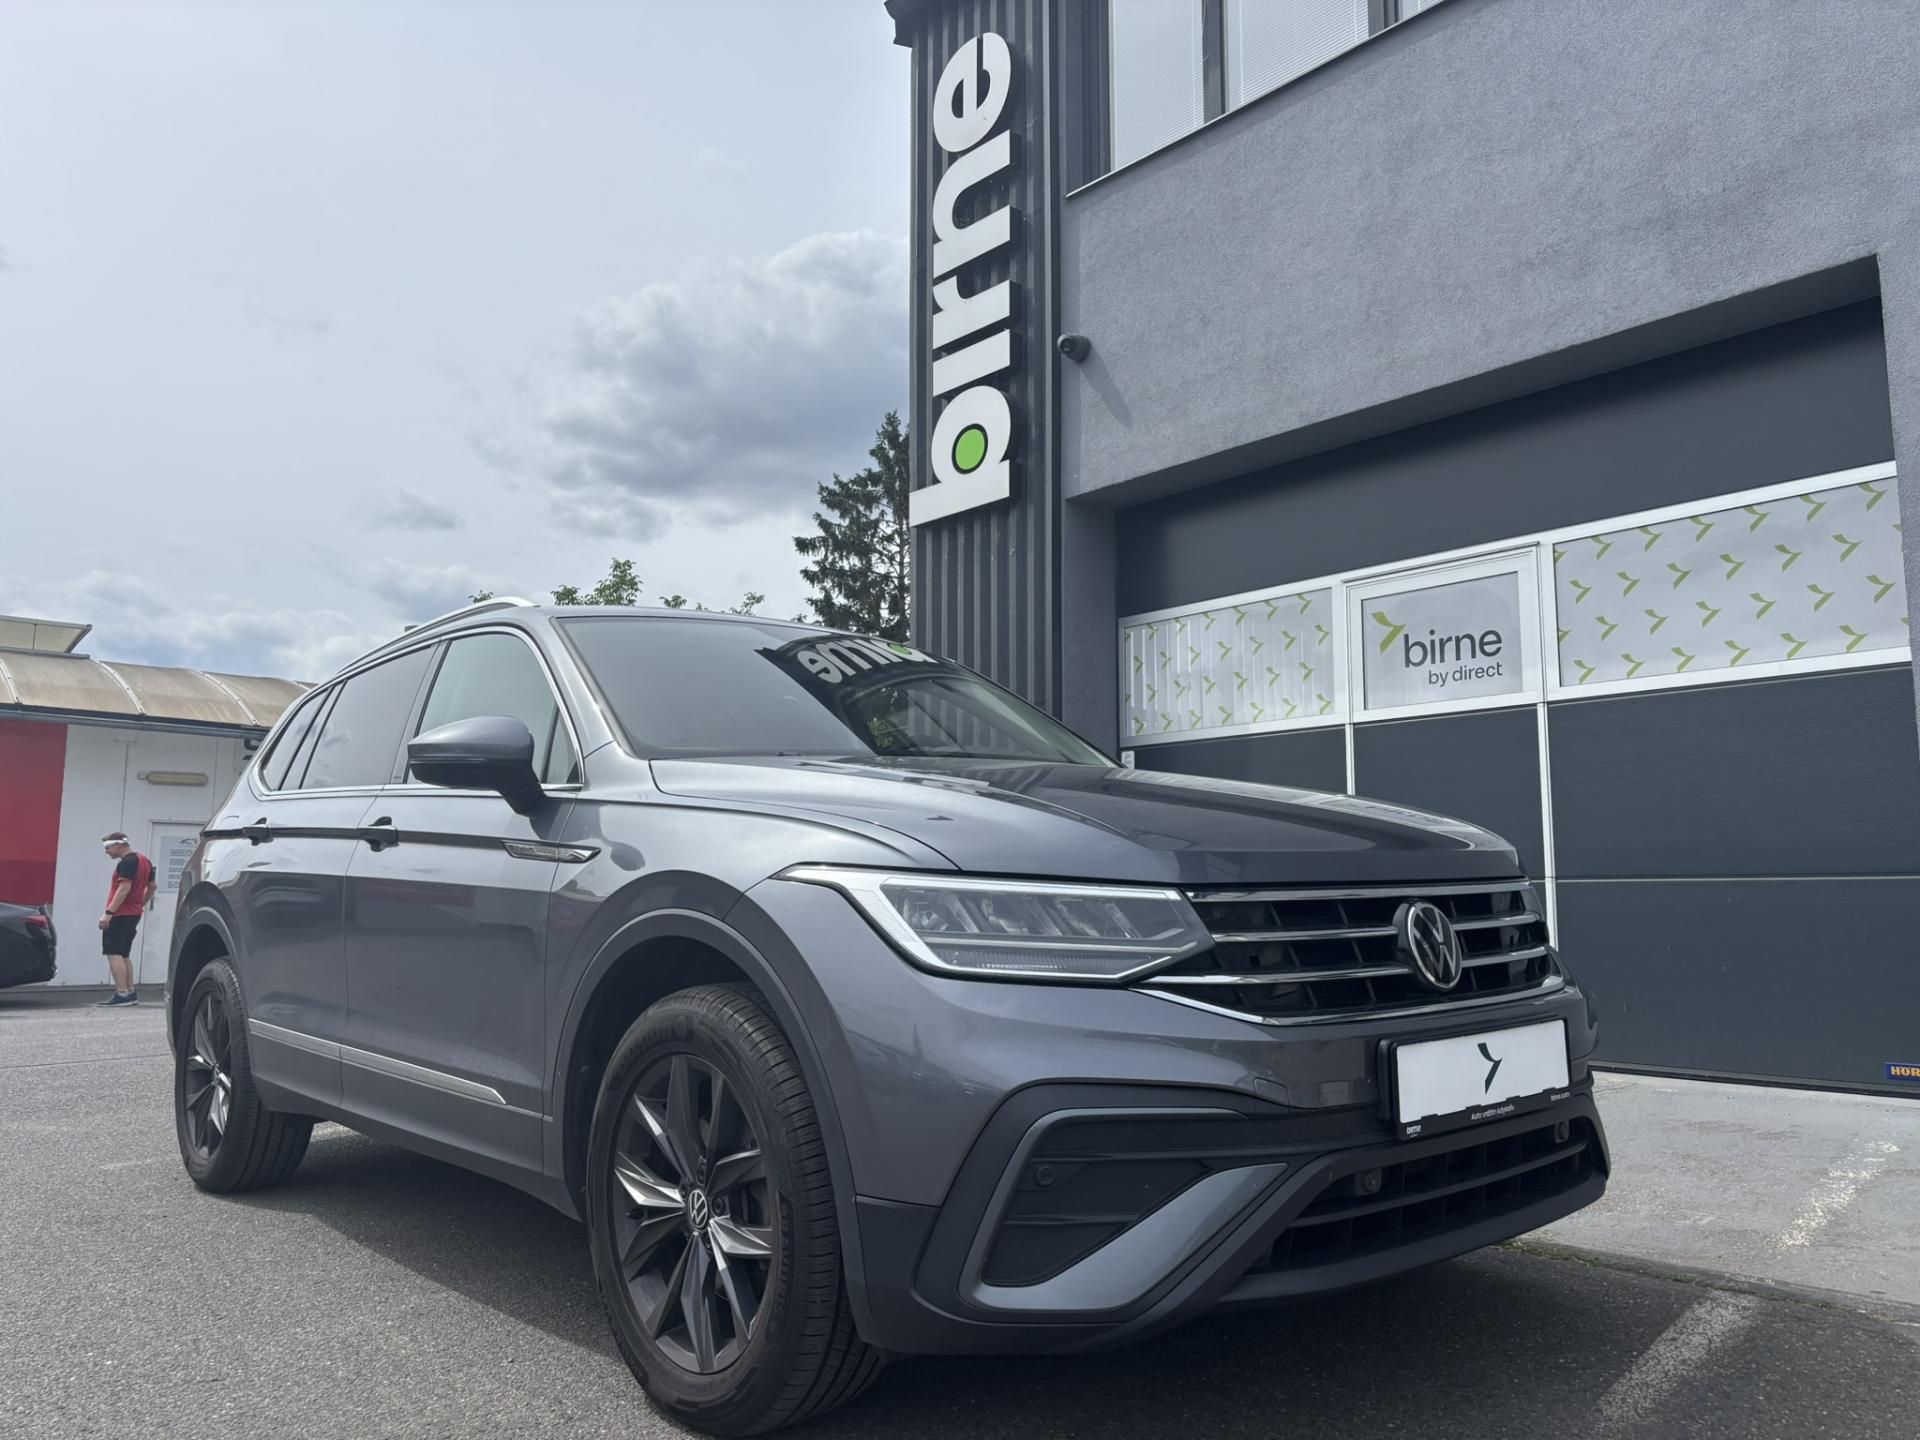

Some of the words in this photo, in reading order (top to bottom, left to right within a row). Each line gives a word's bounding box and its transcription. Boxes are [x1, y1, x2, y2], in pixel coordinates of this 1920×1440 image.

[909, 32, 1011, 527] birne
[1403, 629, 1502, 668] birne
[1428, 670, 1449, 687] by
[1452, 662, 1503, 681] direct
